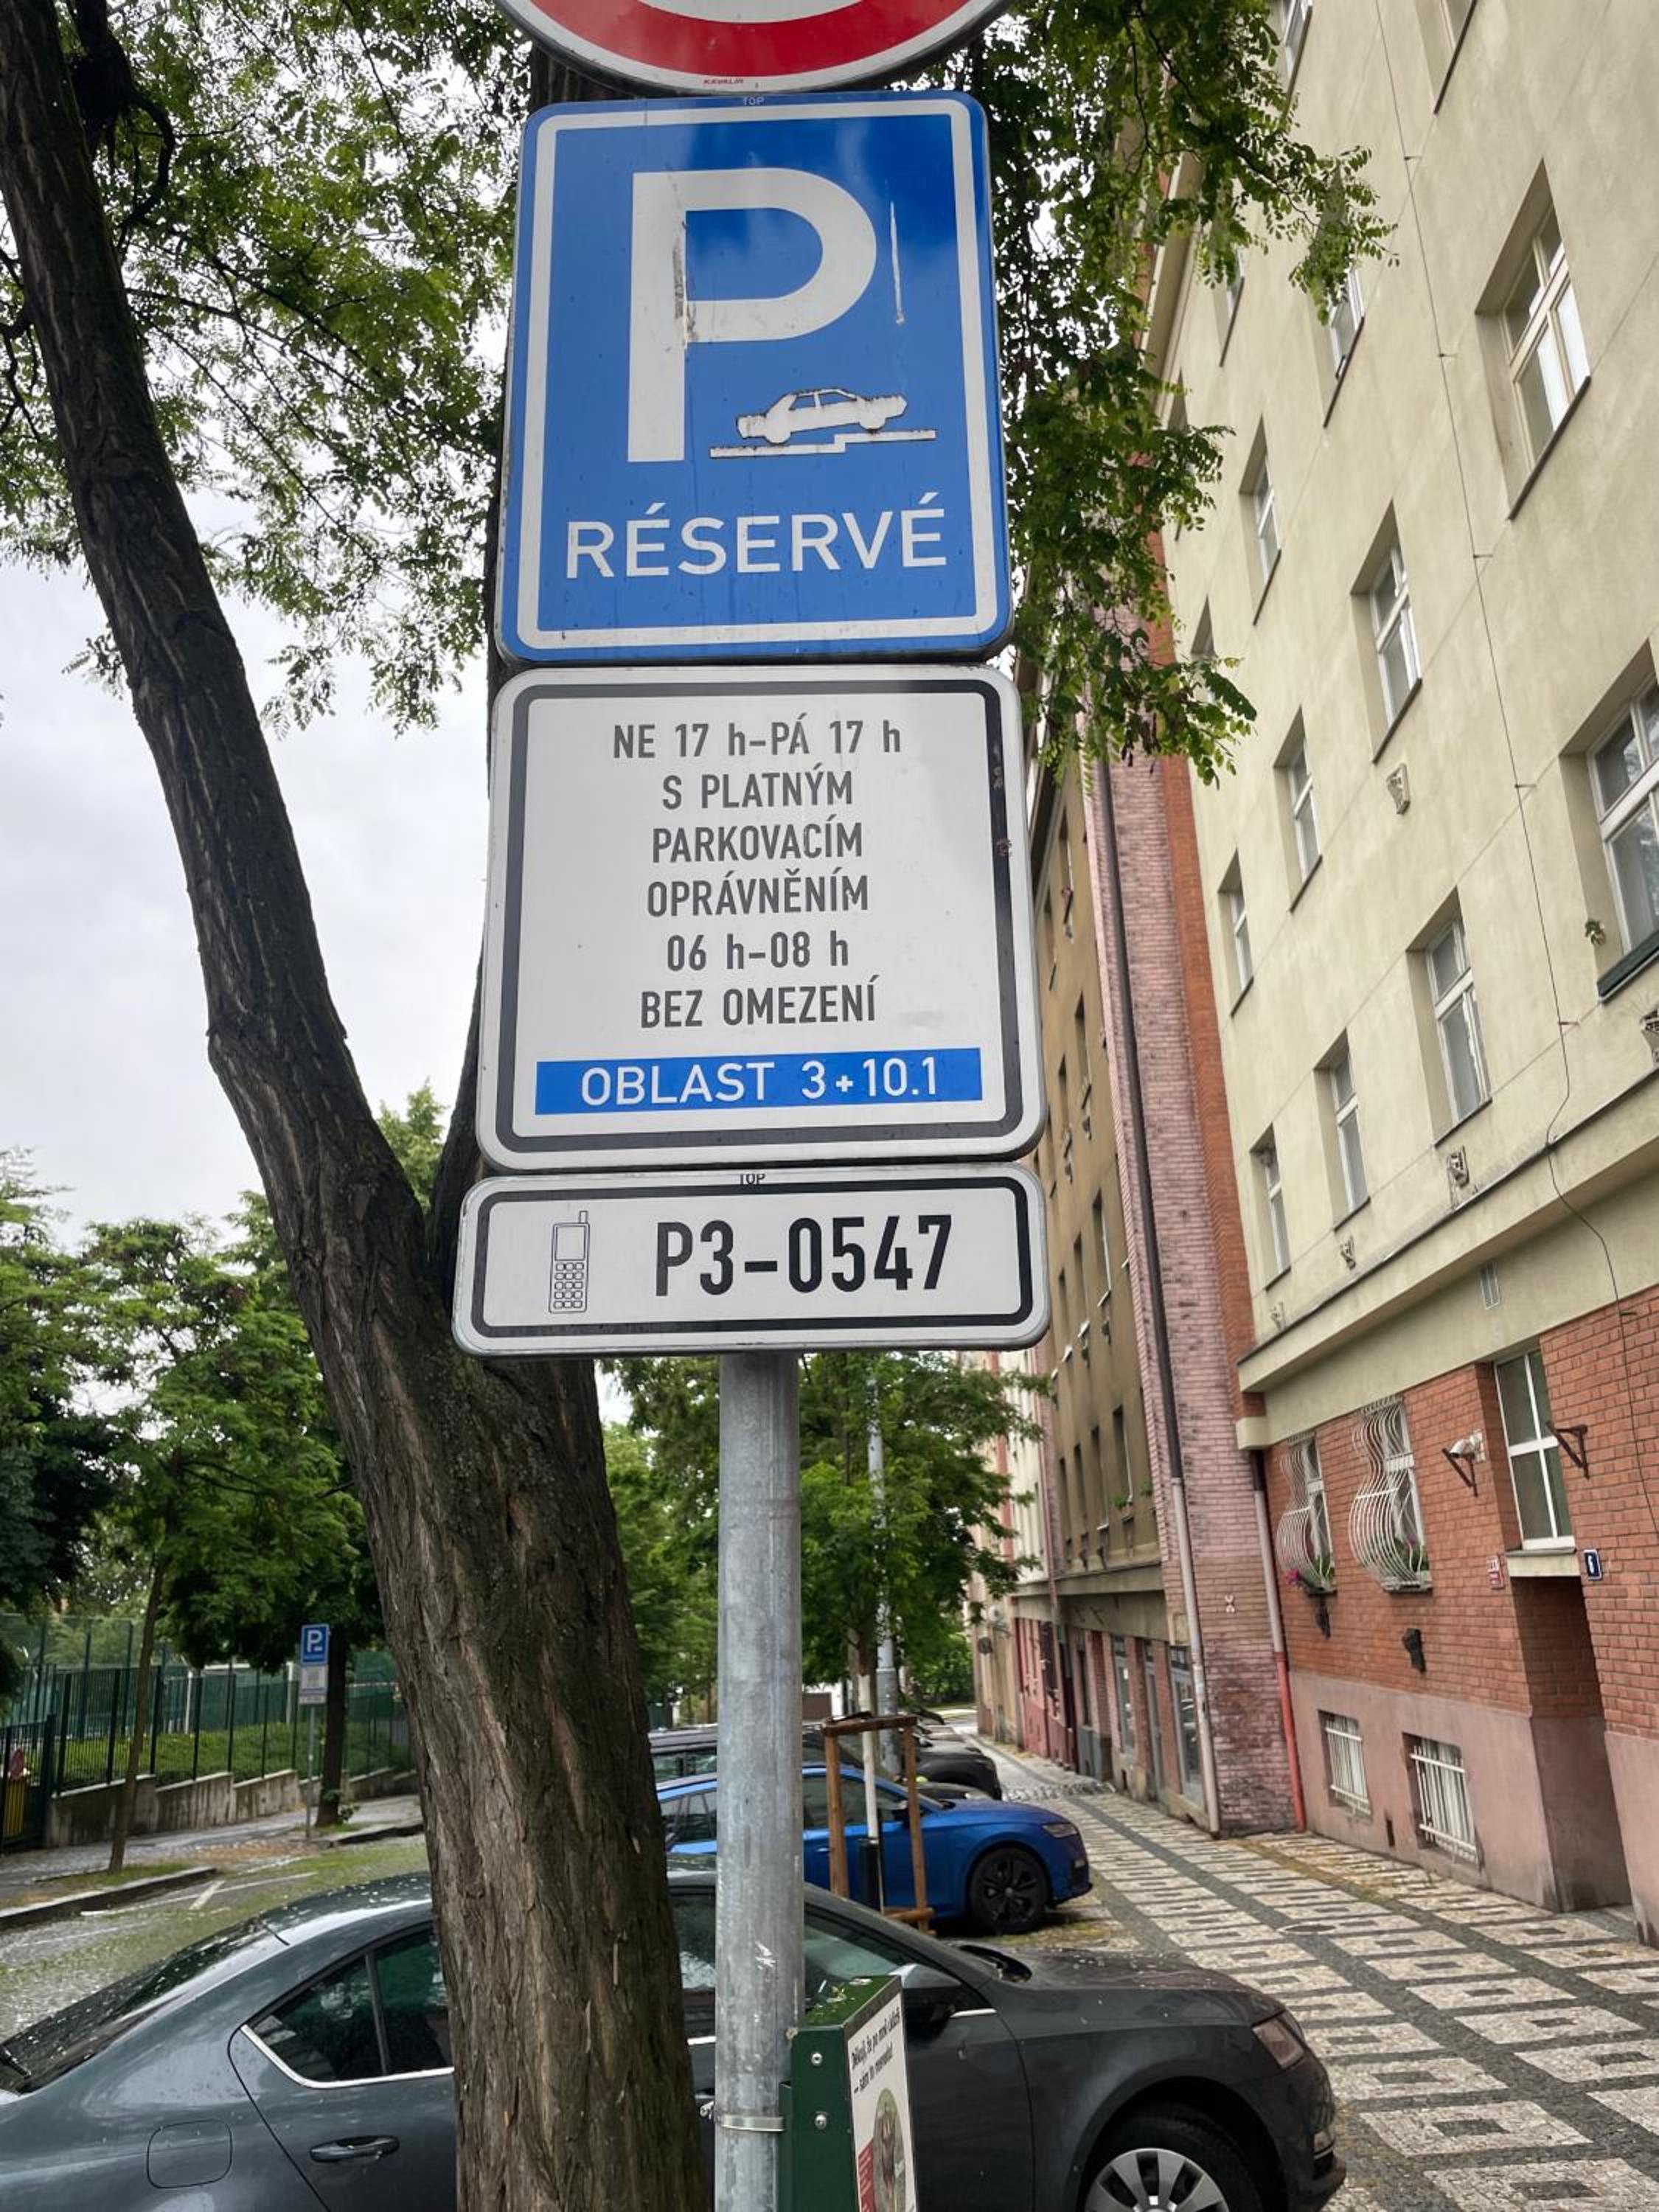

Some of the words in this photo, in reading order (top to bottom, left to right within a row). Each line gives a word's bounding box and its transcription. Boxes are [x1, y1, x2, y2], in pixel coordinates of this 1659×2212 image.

[743, 96, 765, 105] TOP
[628, 168, 877, 462] P
[566, 492, 947, 579] RÉSERVÉ
[613, 724, 655, 759] NE
[675, 723, 709, 757] 17
[829, 720, 863, 754] 17
[883, 719, 900, 753] h
[662, 774, 682, 810] S
[701, 762, 852, 809] PLATNÝM
[653, 813, 862, 863] PARKOVACÍM
[647, 867, 868, 917] OPRÁVNĚNÍM
[667, 934, 707, 972] 06
[830, 930, 849, 967] h
[641, 989, 703, 1029] BEZ
[723, 975, 880, 1026] OMEZENÍ
[581, 1062, 775, 1107] OBLAST
[655, 1214, 952, 1297] P3-0547
